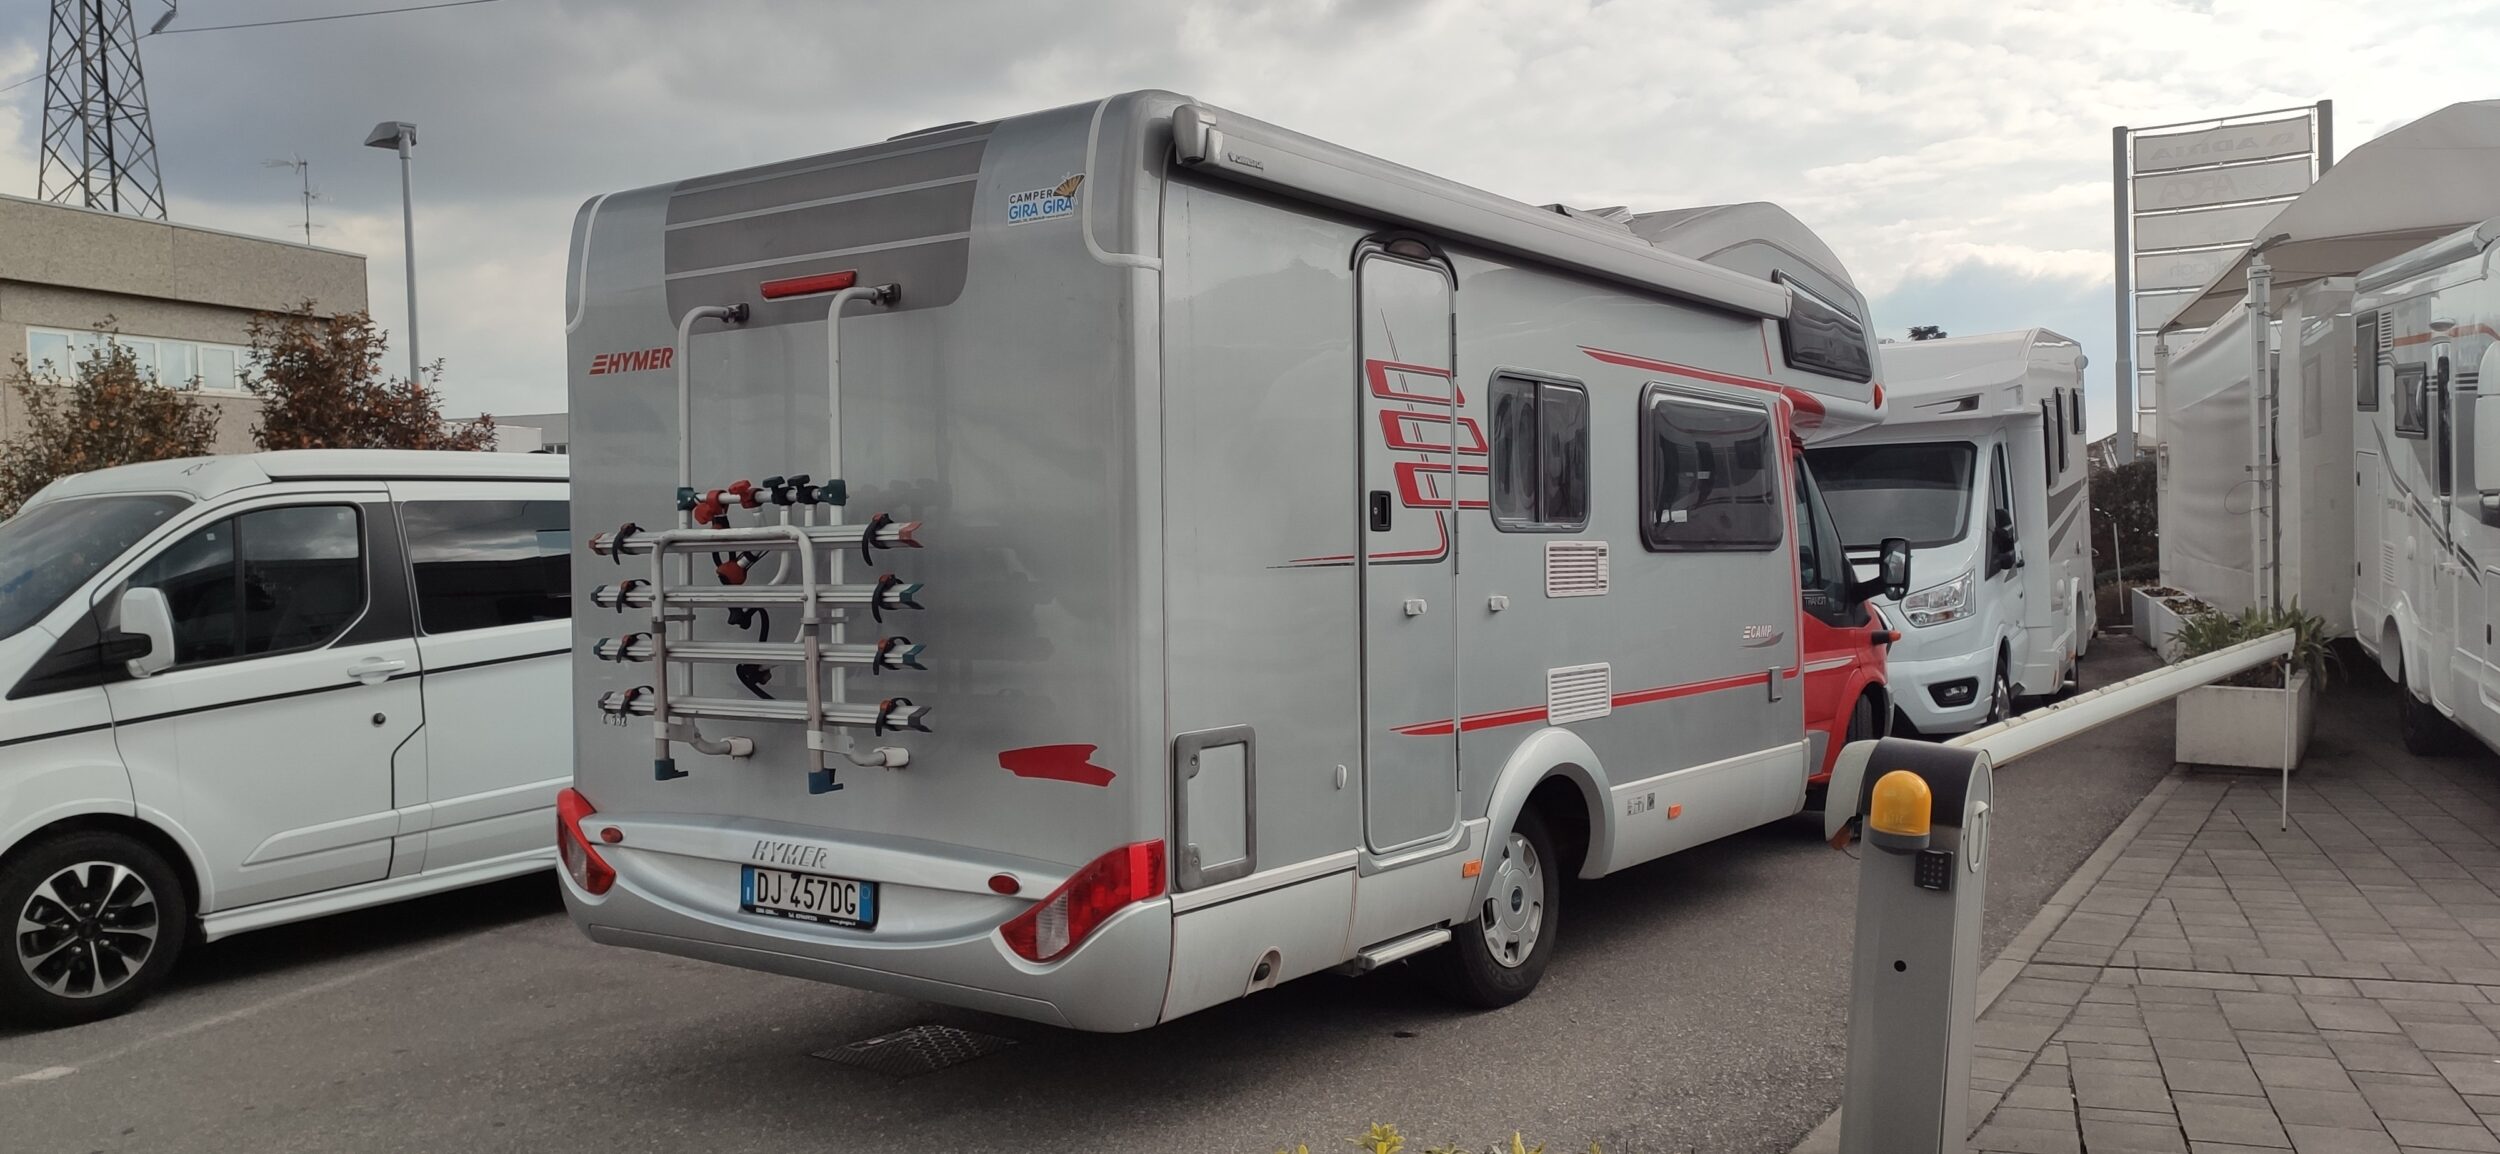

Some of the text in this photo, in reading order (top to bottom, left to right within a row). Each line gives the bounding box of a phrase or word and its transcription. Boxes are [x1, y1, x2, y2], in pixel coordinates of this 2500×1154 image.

[1008, 202, 1039, 220] GIRA
[1043, 196, 1074, 215] GIRA
[1009, 188, 1054, 205] CAMPER
[606, 346, 675, 375] HYMER
[752, 840, 829, 870] HYMER
